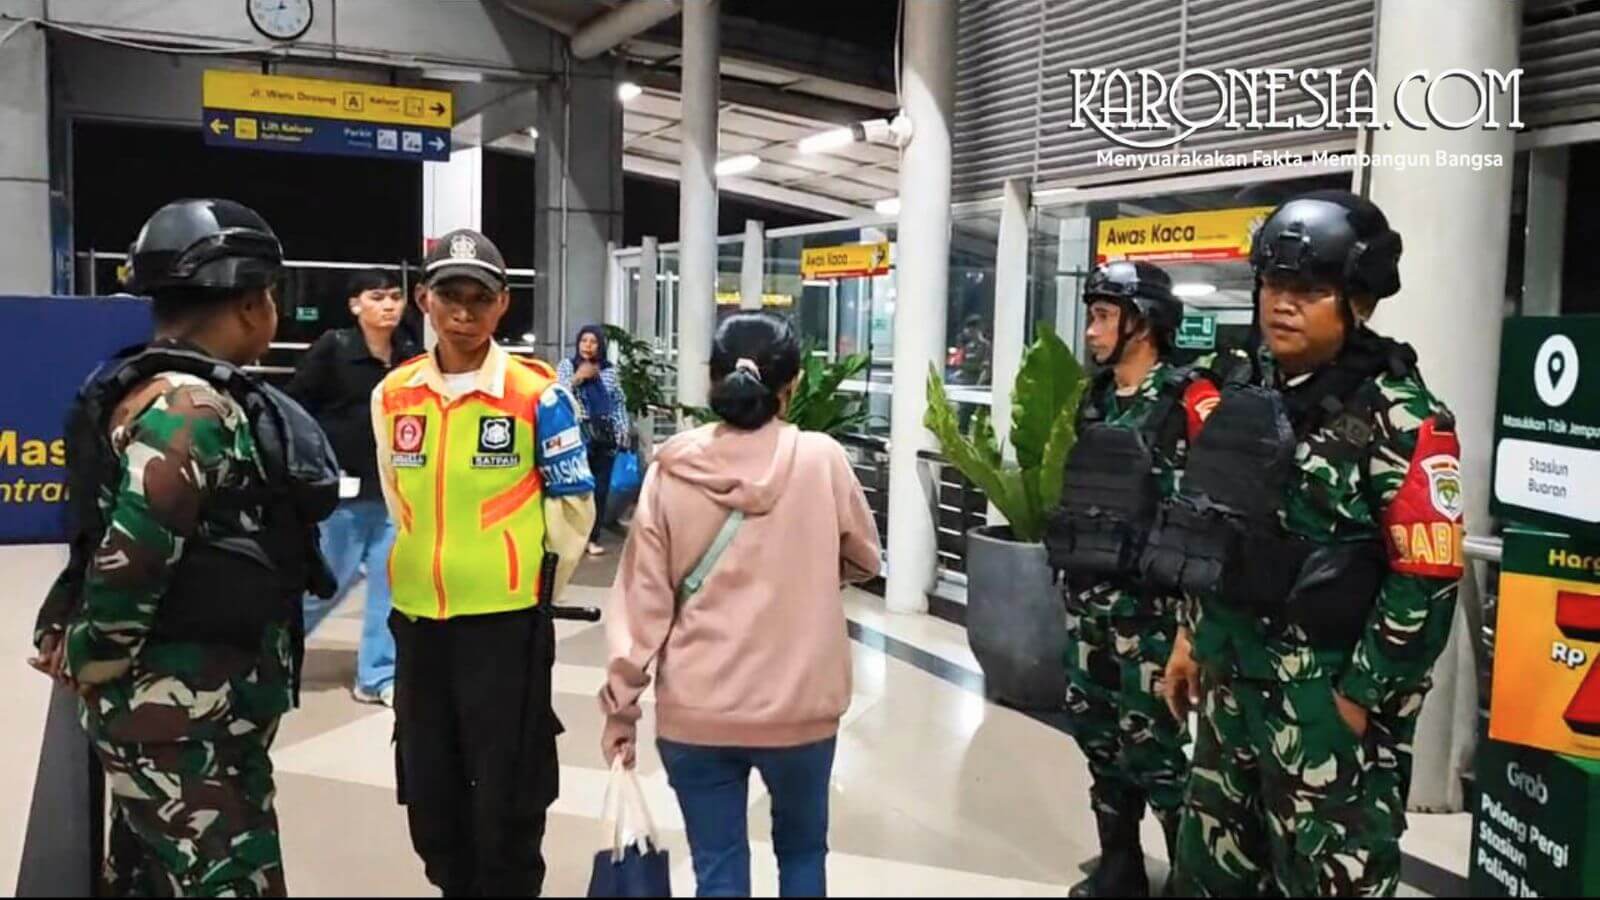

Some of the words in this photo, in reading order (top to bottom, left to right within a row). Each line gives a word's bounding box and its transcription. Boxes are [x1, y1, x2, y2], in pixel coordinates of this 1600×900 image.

[347, 95, 359, 109] A
[1106, 226, 1147, 246] Awas
[1151, 223, 1196, 243] Kaca
[475, 455, 519, 465] SATPAM
[1528, 456, 1569, 477] Stasiun
[1527, 477, 1567, 499] Buaran
[1551, 641, 1585, 668] Rp
[1506, 761, 1549, 805] Grab
[1481, 792, 1528, 843] Pulang
[1529, 824, 1570, 869] Pergi
[1479, 820, 1528, 871] Stasiun
[1477, 846, 1519, 897] Paling
